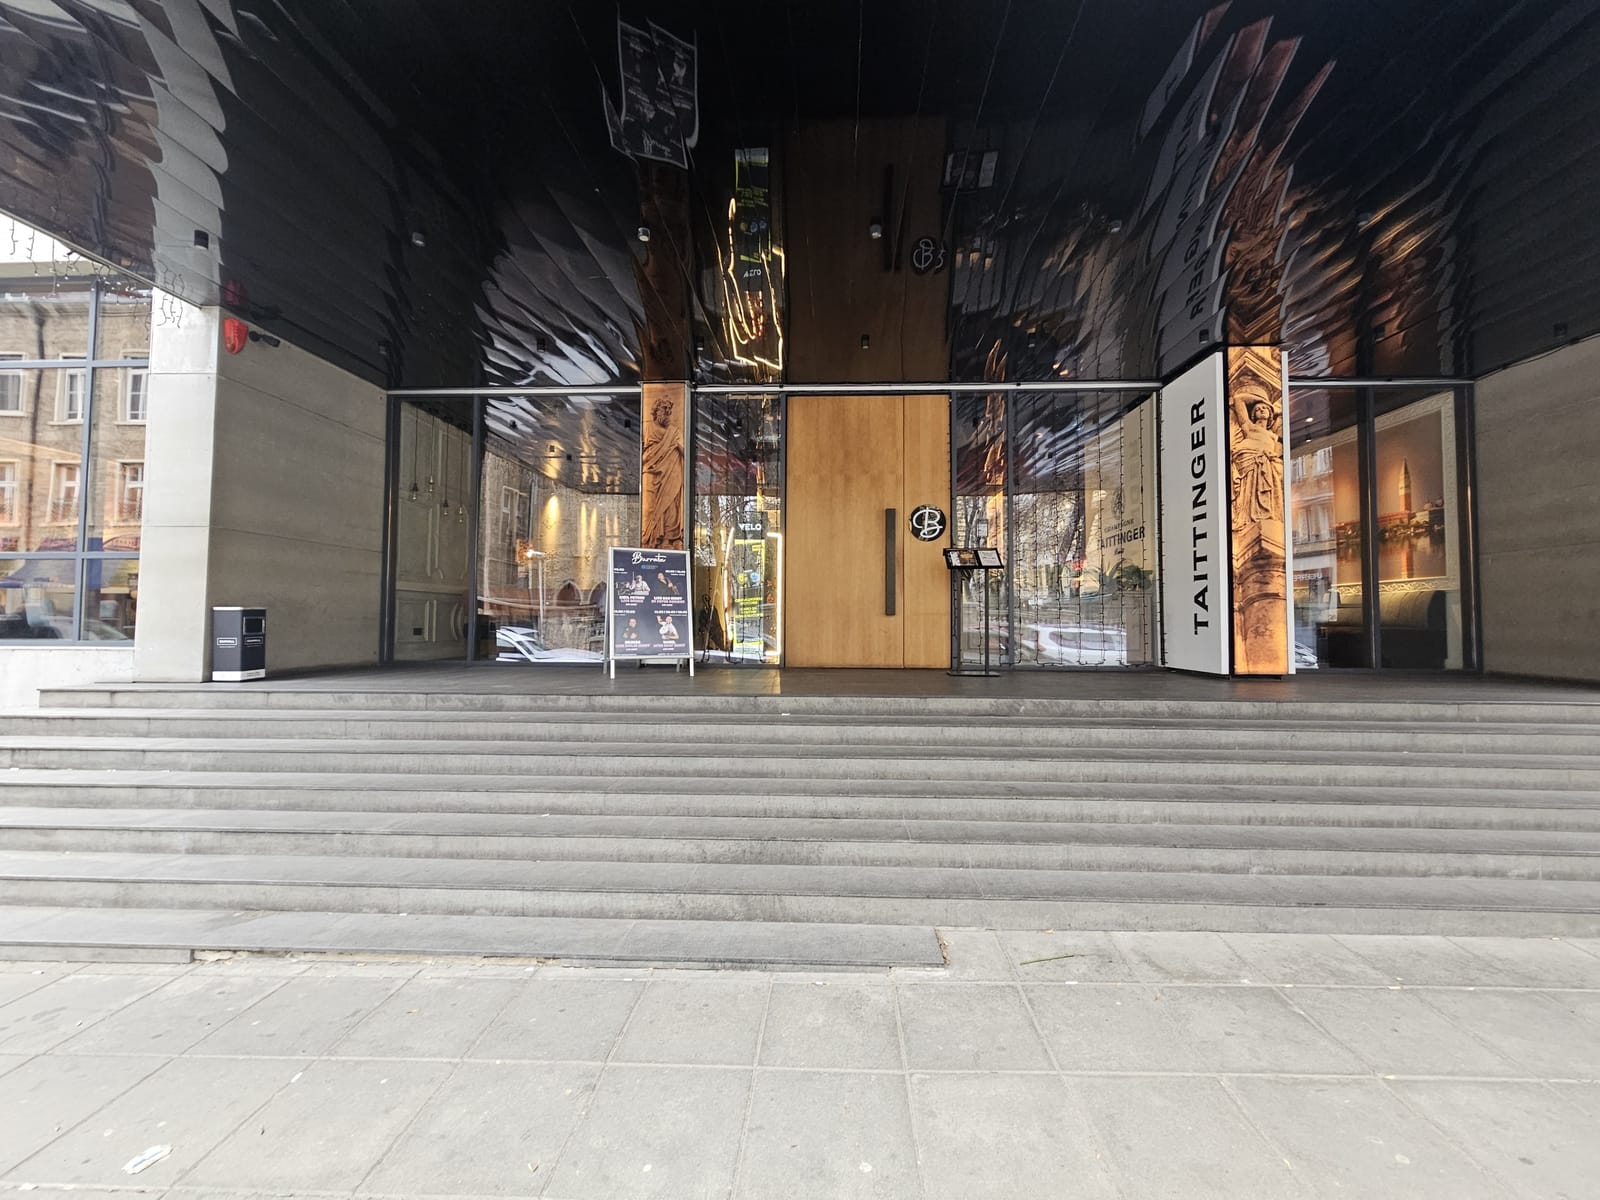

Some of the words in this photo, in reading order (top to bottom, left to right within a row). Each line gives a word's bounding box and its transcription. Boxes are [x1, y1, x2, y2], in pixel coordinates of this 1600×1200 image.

[738, 523, 762, 531] VELO
[912, 507, 943, 538] B
[1190, 398, 1209, 635] TAITTINGER
